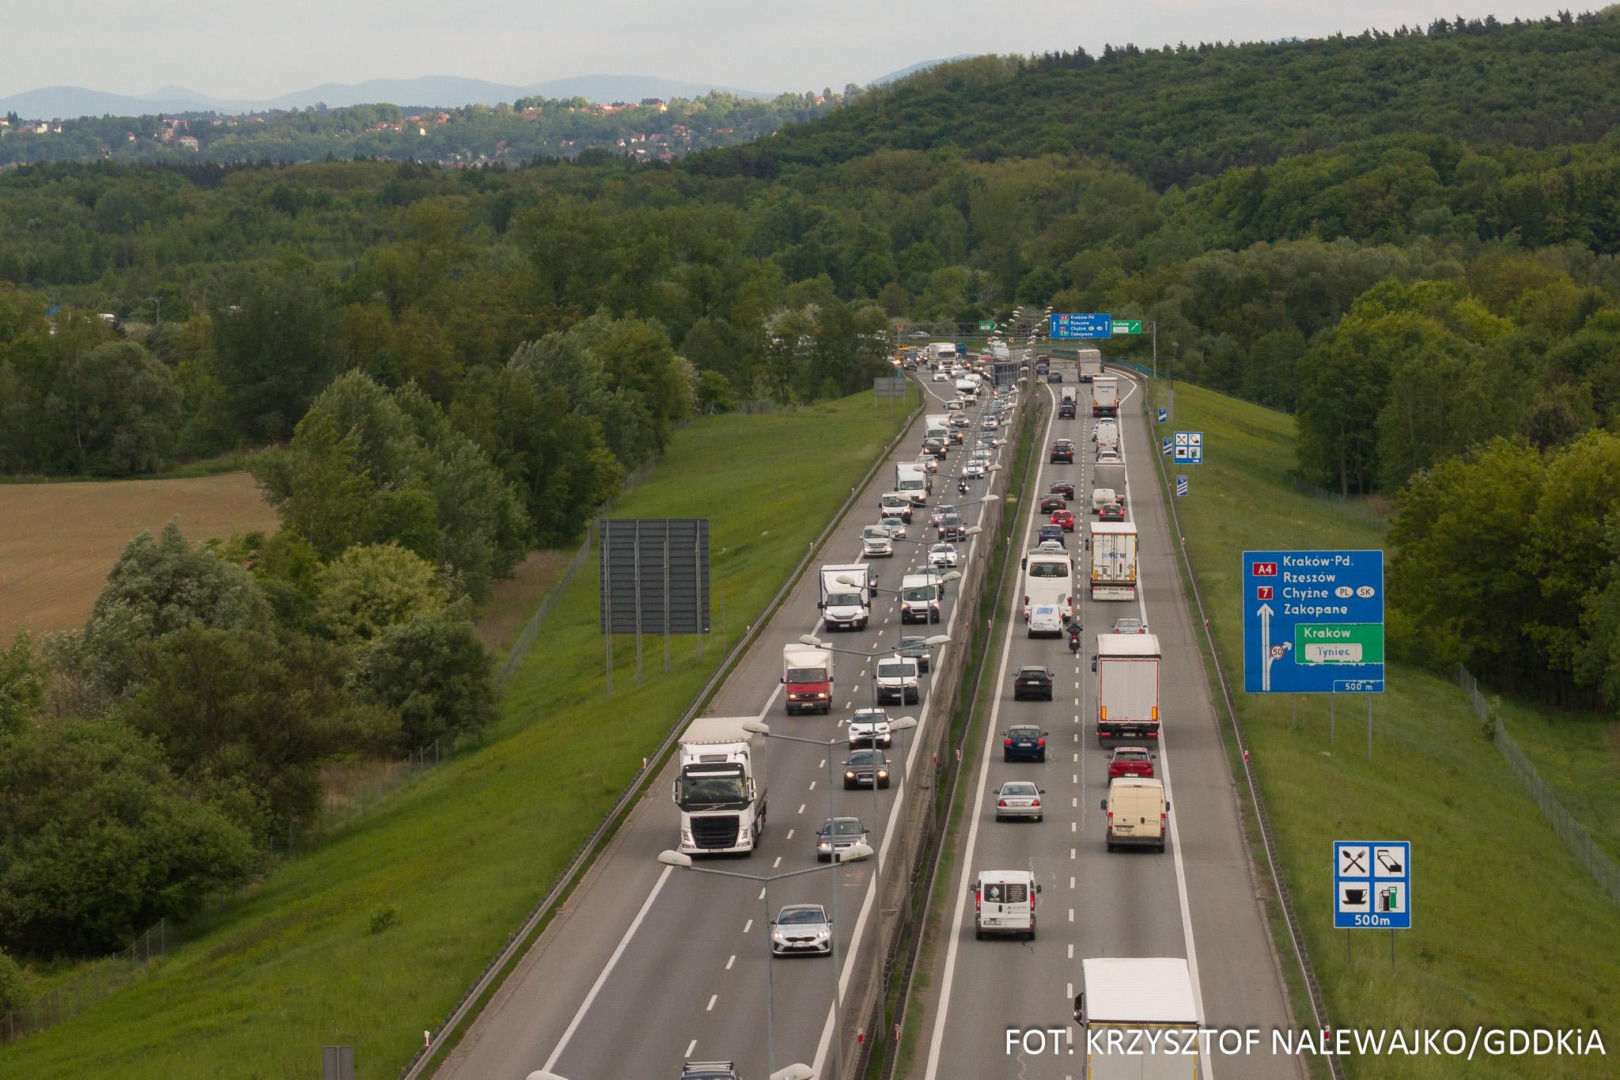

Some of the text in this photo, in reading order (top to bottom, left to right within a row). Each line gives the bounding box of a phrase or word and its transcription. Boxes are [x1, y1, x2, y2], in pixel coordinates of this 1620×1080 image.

[1258, 564, 1272, 574] A4
[1283, 571, 1336, 583] Rzeszów
[1262, 588, 1269, 598] 7
[1283, 587, 1329, 601] Chyżne
[1339, 588, 1350, 596] PL
[1360, 588, 1371, 596] SK
[1284, 603, 1348, 617] Zakopane
[1304, 627, 1351, 638] Kraków
[1272, 648, 1283, 656] 50
[1317, 647, 1350, 657] Tyniec
[1345, 683, 1361, 691] 500
